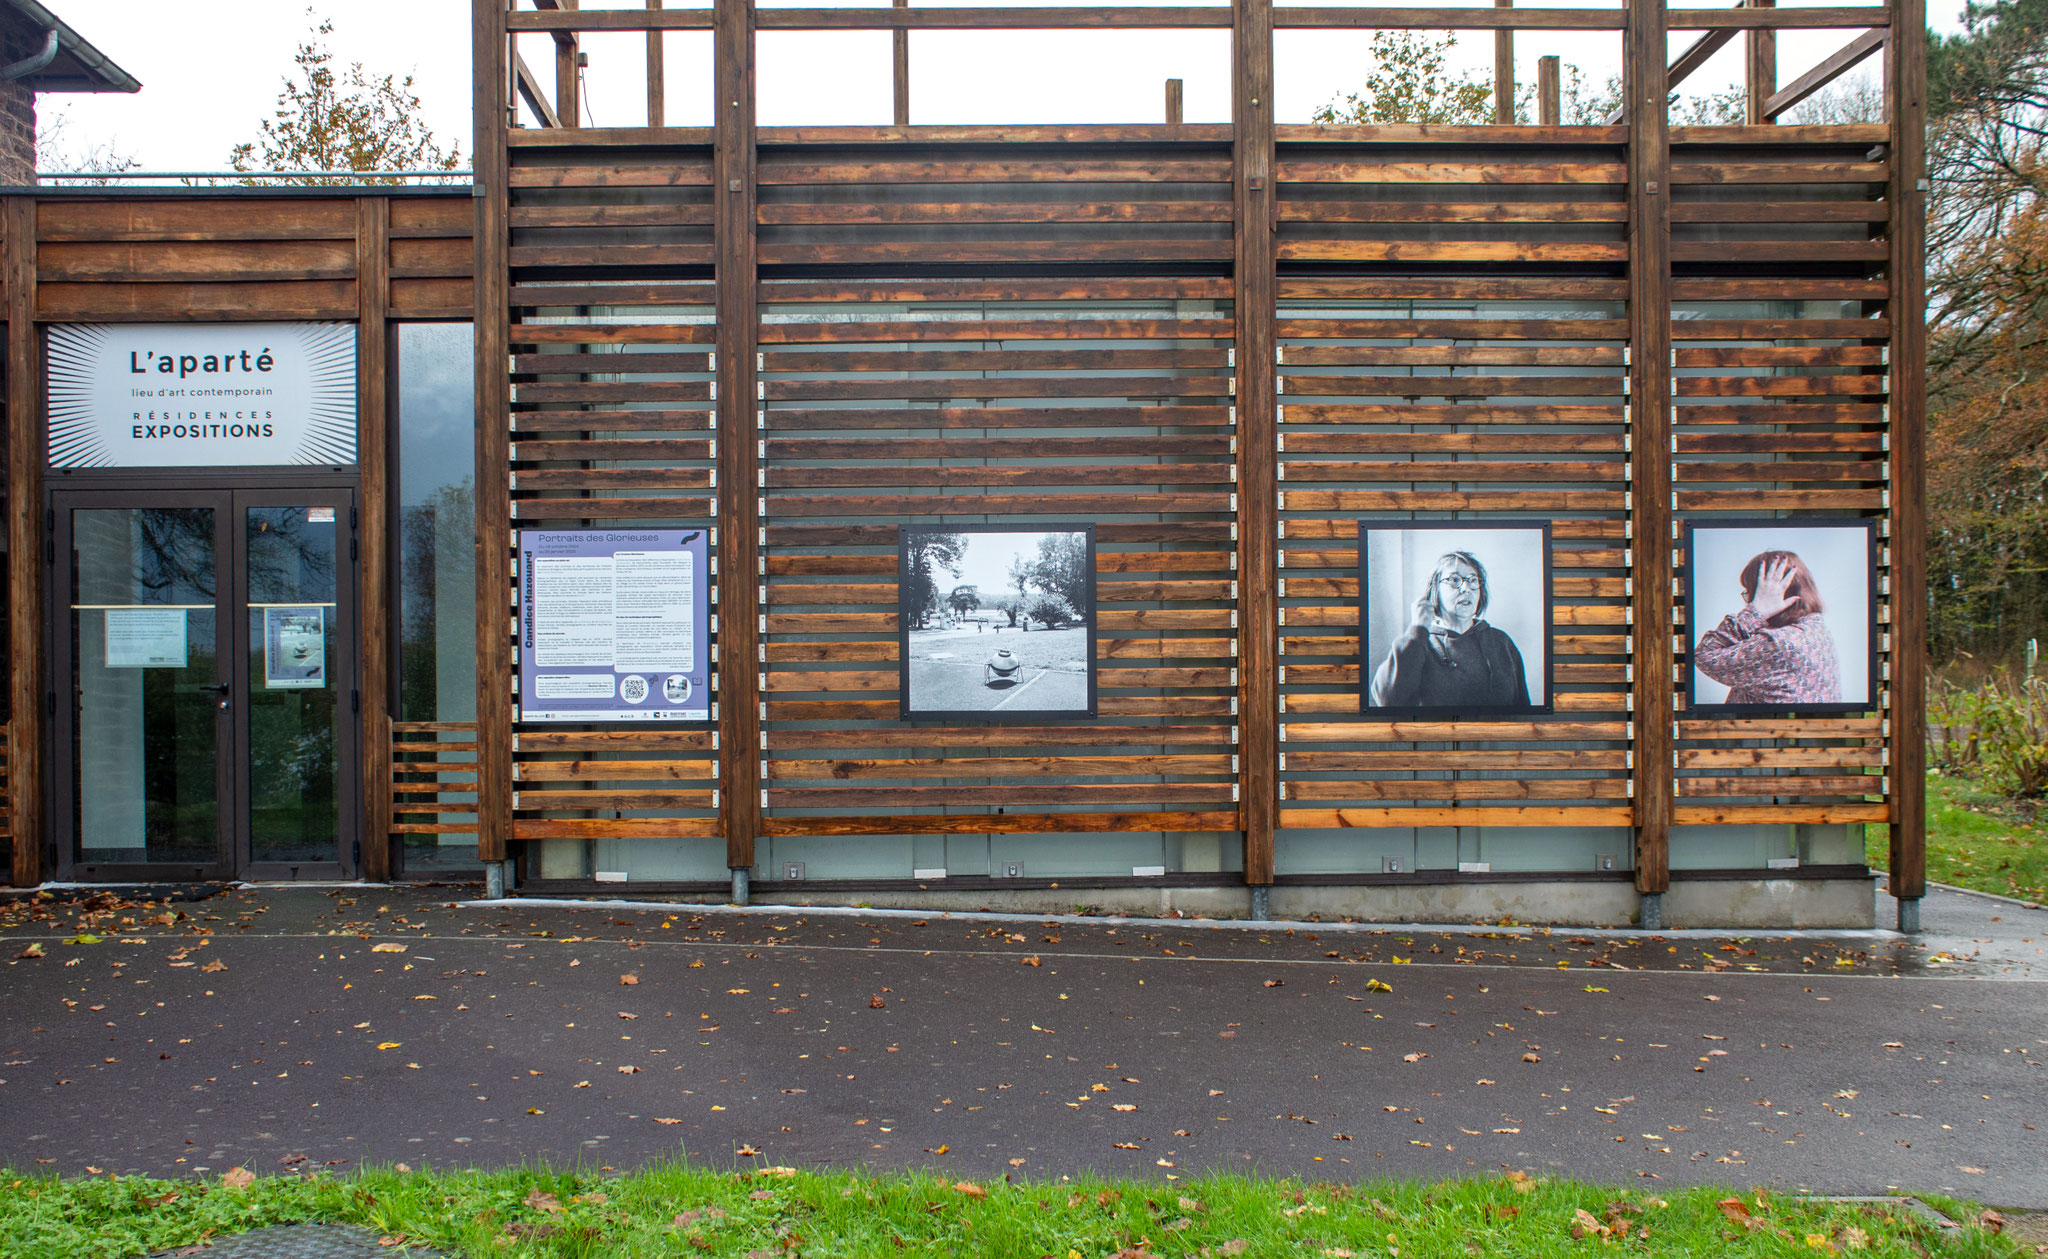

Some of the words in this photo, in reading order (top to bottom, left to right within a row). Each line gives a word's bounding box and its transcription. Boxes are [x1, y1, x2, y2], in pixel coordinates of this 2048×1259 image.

[132, 388, 154, 397] lieu
[190, 387, 273, 398] contemporain
[133, 410, 273, 420] RÉSIDENCES
[132, 424, 274, 439] EXPOSITIONS
[538, 534, 585, 543] Portraits
[586, 534, 604, 542] des
[606, 533, 659, 542] Glorieuses
[524, 550, 533, 604] Hazouard
[525, 605, 533, 649] Candice
